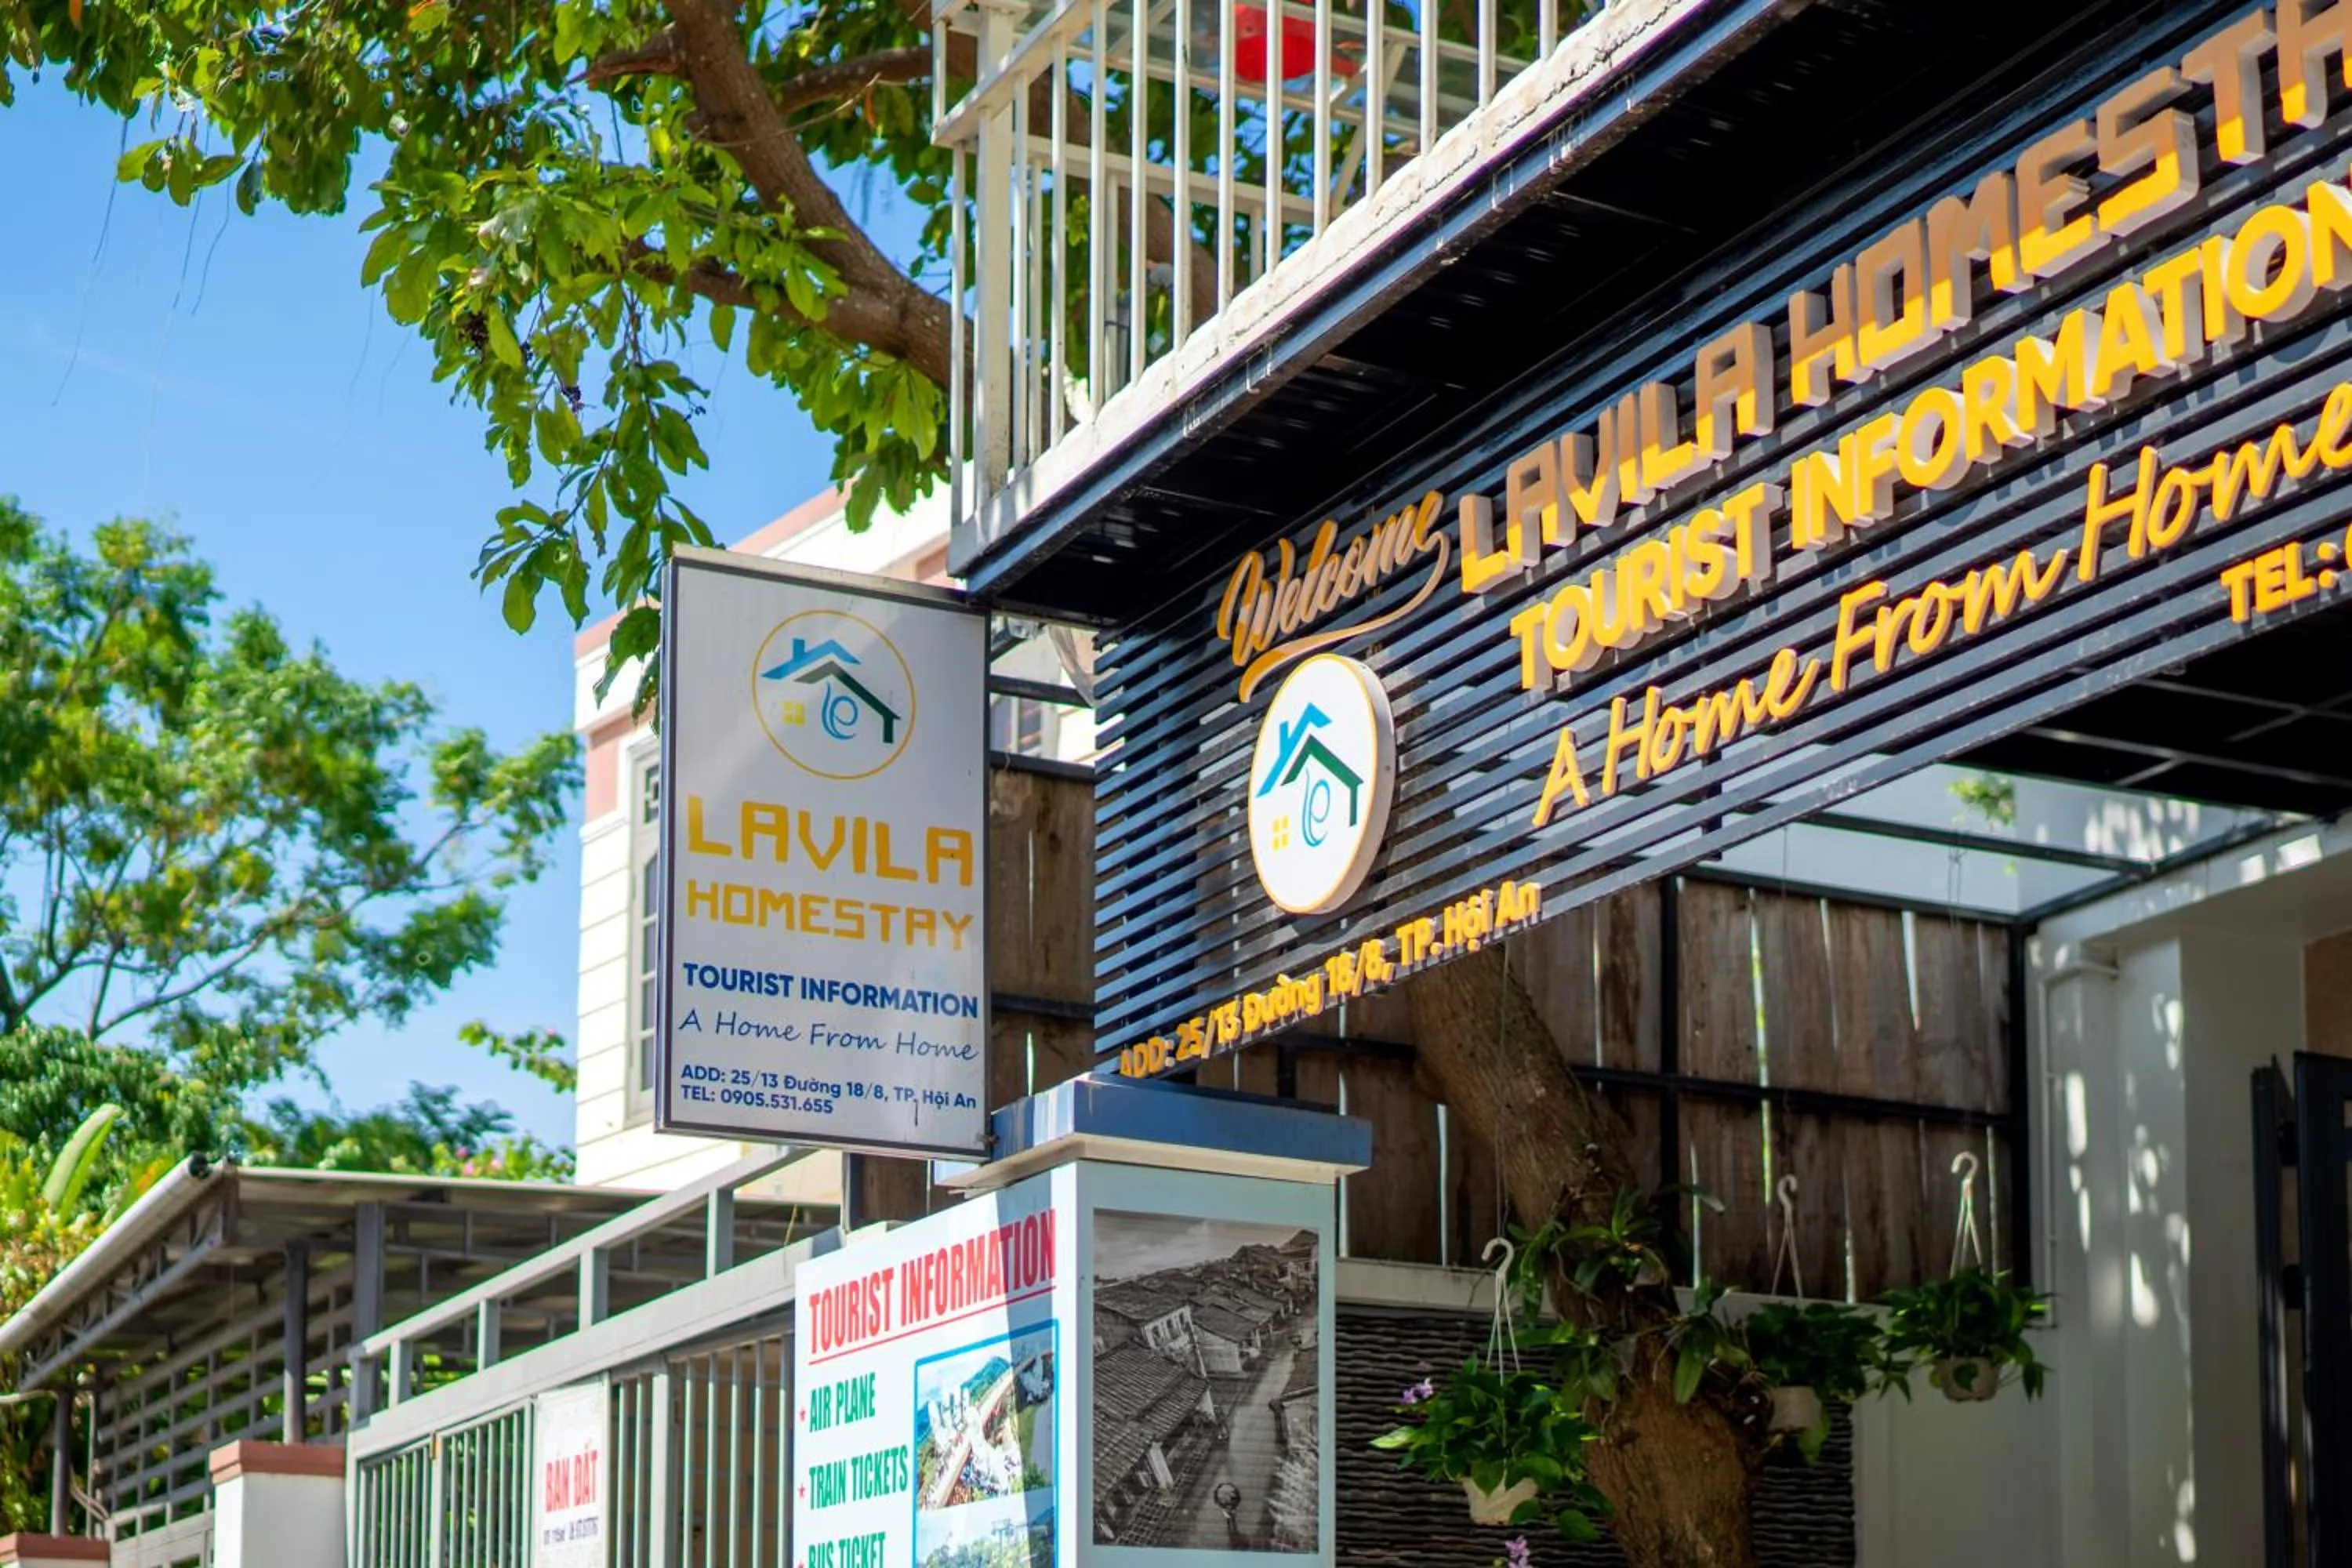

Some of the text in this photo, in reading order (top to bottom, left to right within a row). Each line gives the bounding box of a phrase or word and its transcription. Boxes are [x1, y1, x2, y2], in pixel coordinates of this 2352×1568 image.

[1459, 321, 1774, 594] LAVILA
[1510, 162, 2352, 691] TOURIST INFORMATION
[1216, 490, 1450, 702] Welcome
[1531, 382, 2352, 828] A Home From Home
[687, 794, 974, 886] LAVILA
[686, 879, 975, 950] HOMESTAY
[682, 962, 978, 1018] TOURIST INFORMATION
[1119, 880, 1543, 1079] ADD: 25/13 Đường 18/8, TP. Hội An
[678, 1009, 979, 1062] A Home From Home
[681, 1064, 726, 1083] ADD:
[731, 1069, 779, 1088] 25/13
[784, 1074, 841, 1098] Đường
[846, 1081, 889, 1102] 18/8,
[923, 1089, 949, 1110] Hội
[953, 1092, 977, 1109] An
[681, 1084, 834, 1114] TEL: 0905.531.655
[808, 1208, 1056, 1356] TOURIST INFORMATION
[809, 1371, 876, 1433] AIR PLANE
[808, 1444, 909, 1511] TRAIN TICKETS
[838, 1531, 886, 1568] TICKET
